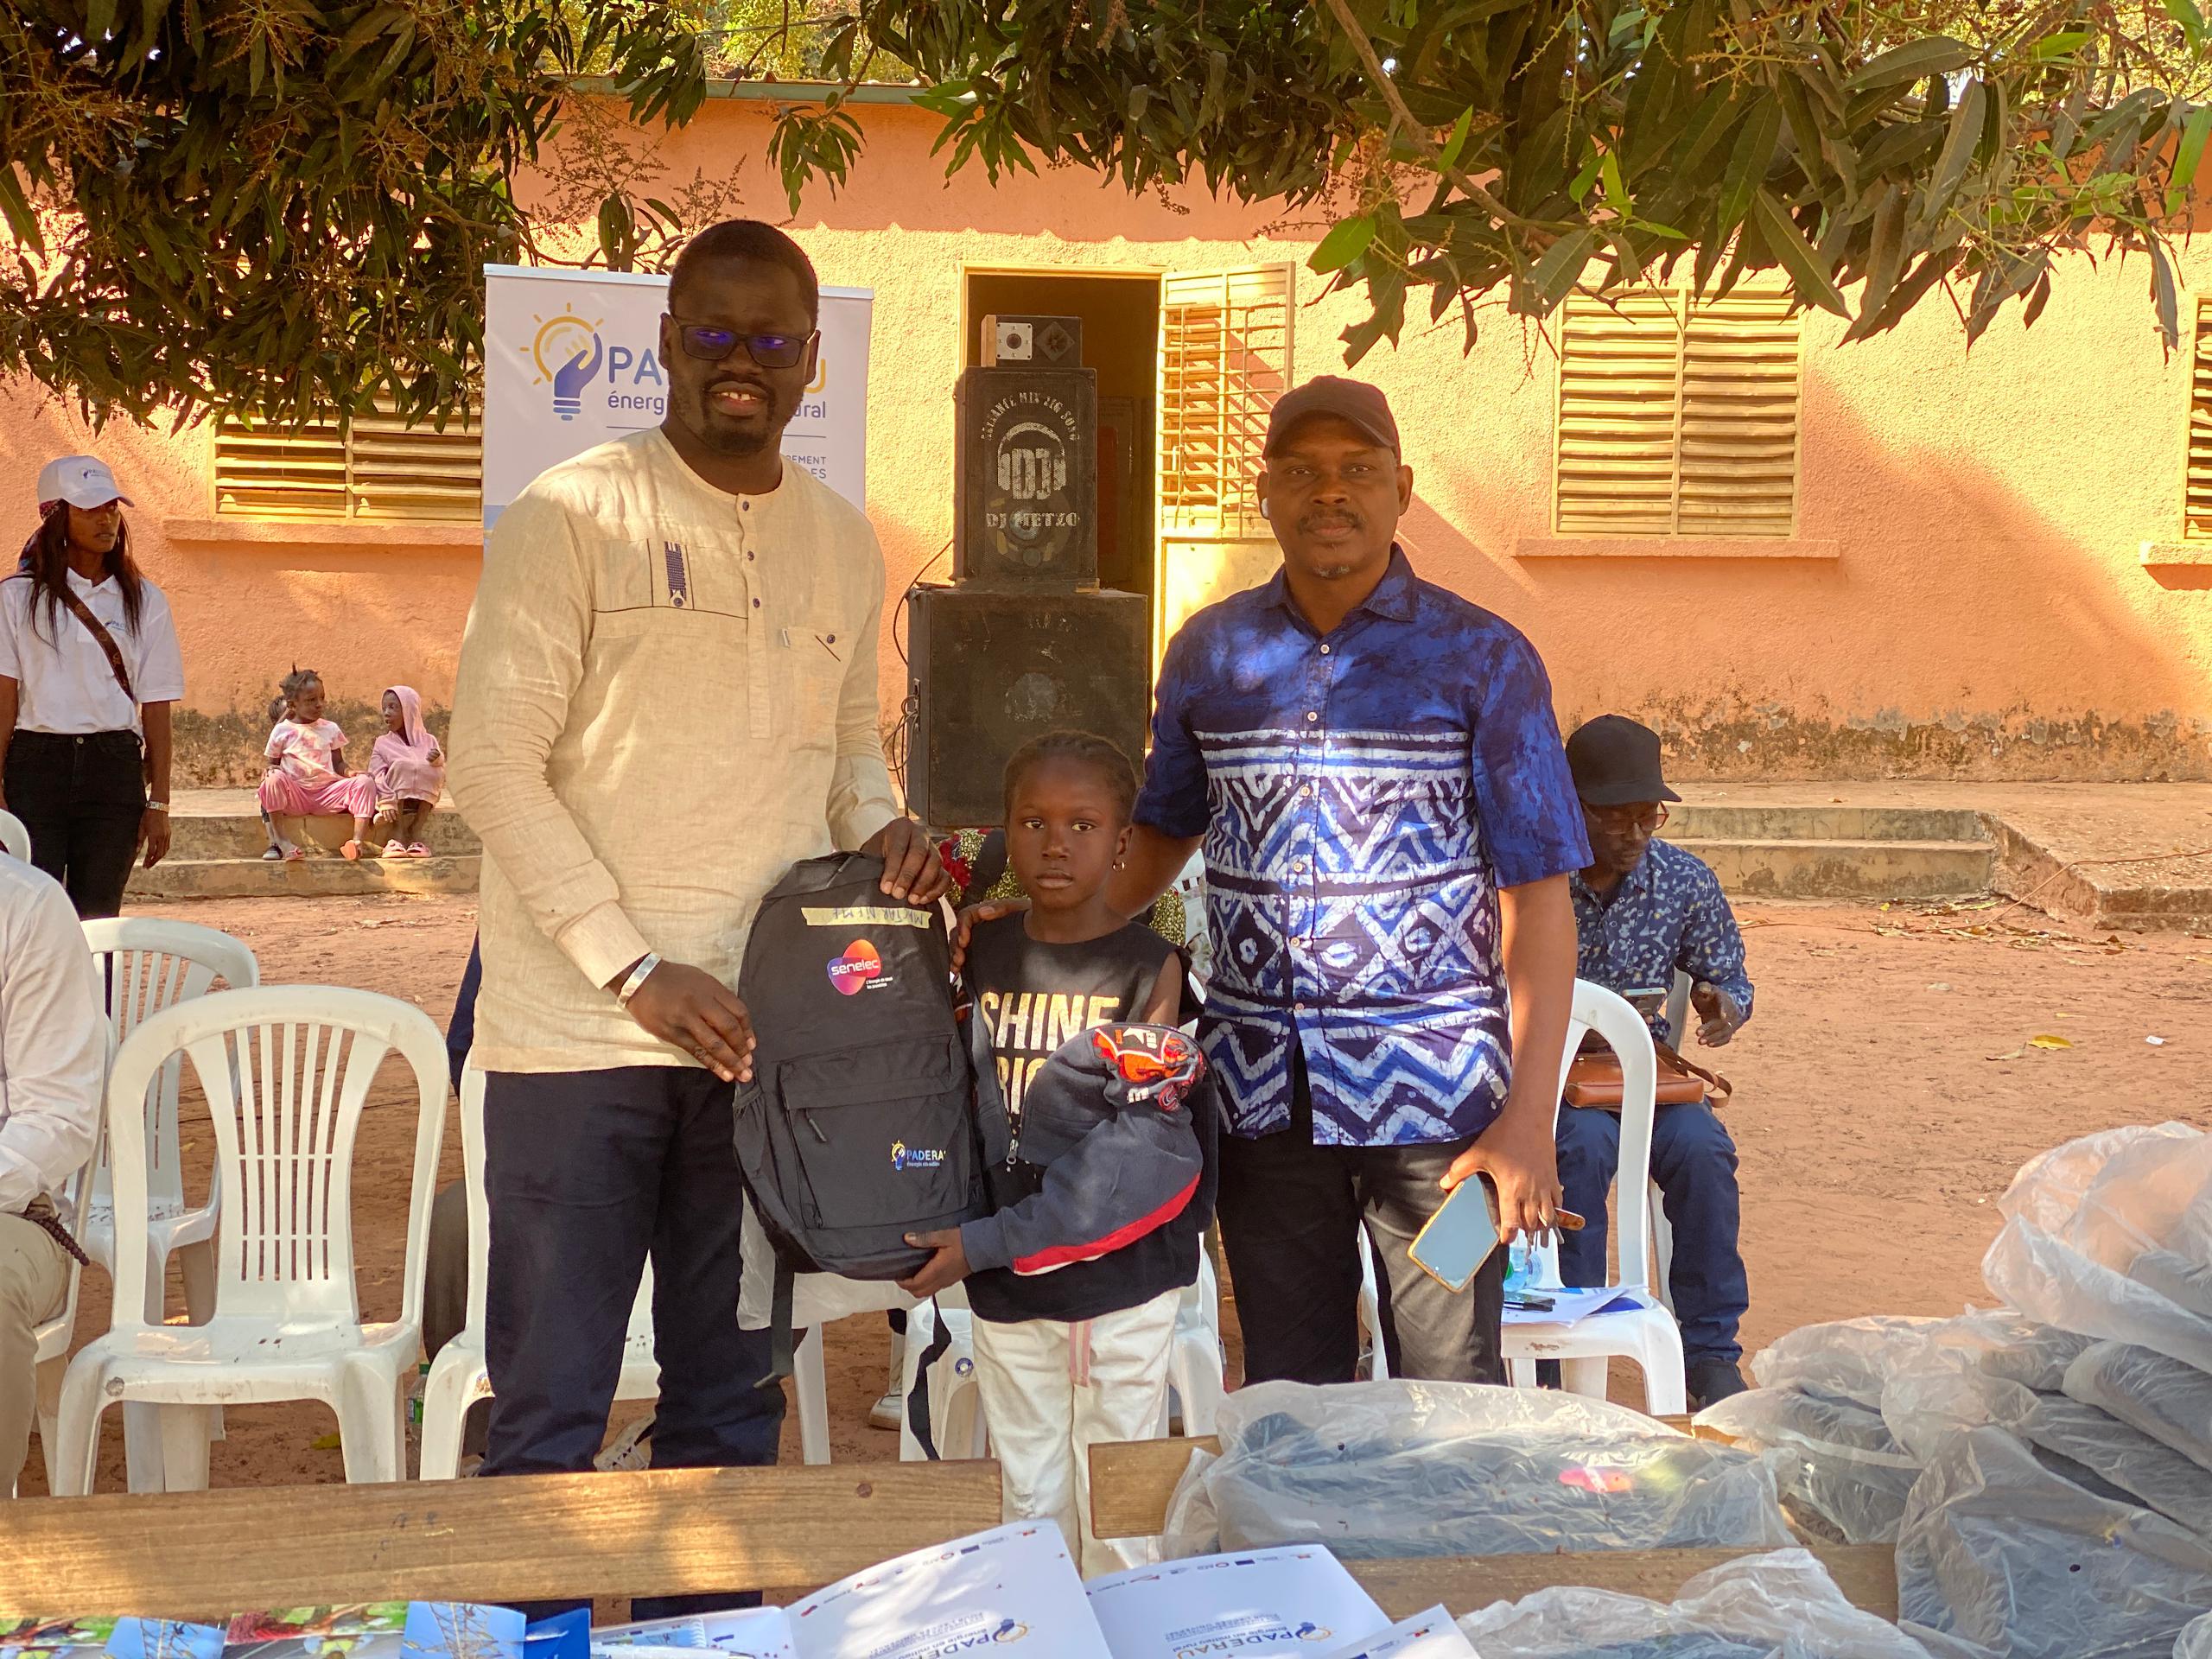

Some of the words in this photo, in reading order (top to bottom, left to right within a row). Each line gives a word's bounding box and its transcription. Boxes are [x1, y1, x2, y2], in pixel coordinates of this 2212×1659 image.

[607, 390, 664, 416] énerg
[1012, 448, 1052, 500] DJ
[985, 512, 1007, 529] DJ
[830, 958, 880, 976] senelec
[906, 1149, 946, 1161] PADERA
